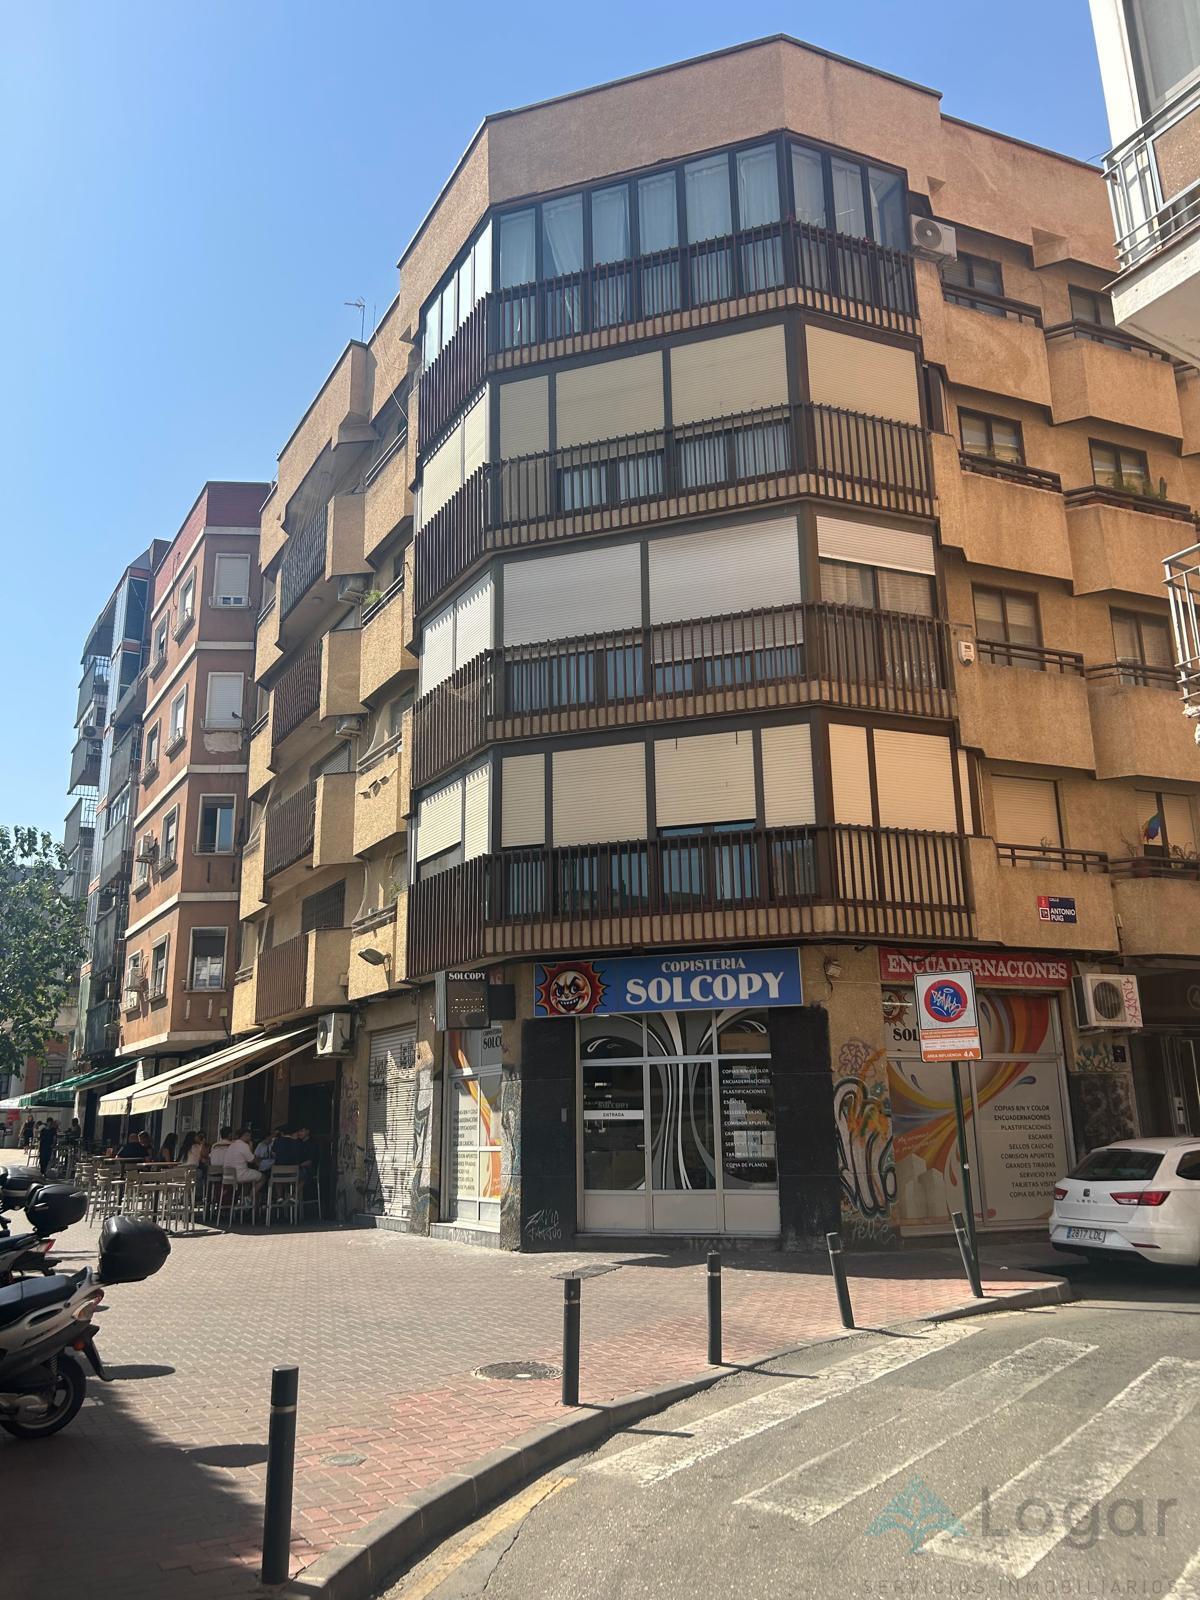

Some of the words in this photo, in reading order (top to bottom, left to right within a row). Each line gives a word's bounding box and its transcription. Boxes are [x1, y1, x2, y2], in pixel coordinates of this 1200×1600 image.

[1050, 907, 1076, 916] ANTONIO
[1051, 914, 1065, 922] PUIG
[660, 956, 747, 974] COPISTERIA
[887, 953, 1068, 980] ENCUADERNACIONES
[448, 971, 487, 981] SOLCOPY
[625, 971, 785, 1006] SOLCOPY
[994, 1104, 1015, 1112] COPIAS
[1031, 1104, 1050, 1112] COLOR
[1027, 1190, 1036, 1198] DE
[1072, 1228, 1089, 1239] 2817
